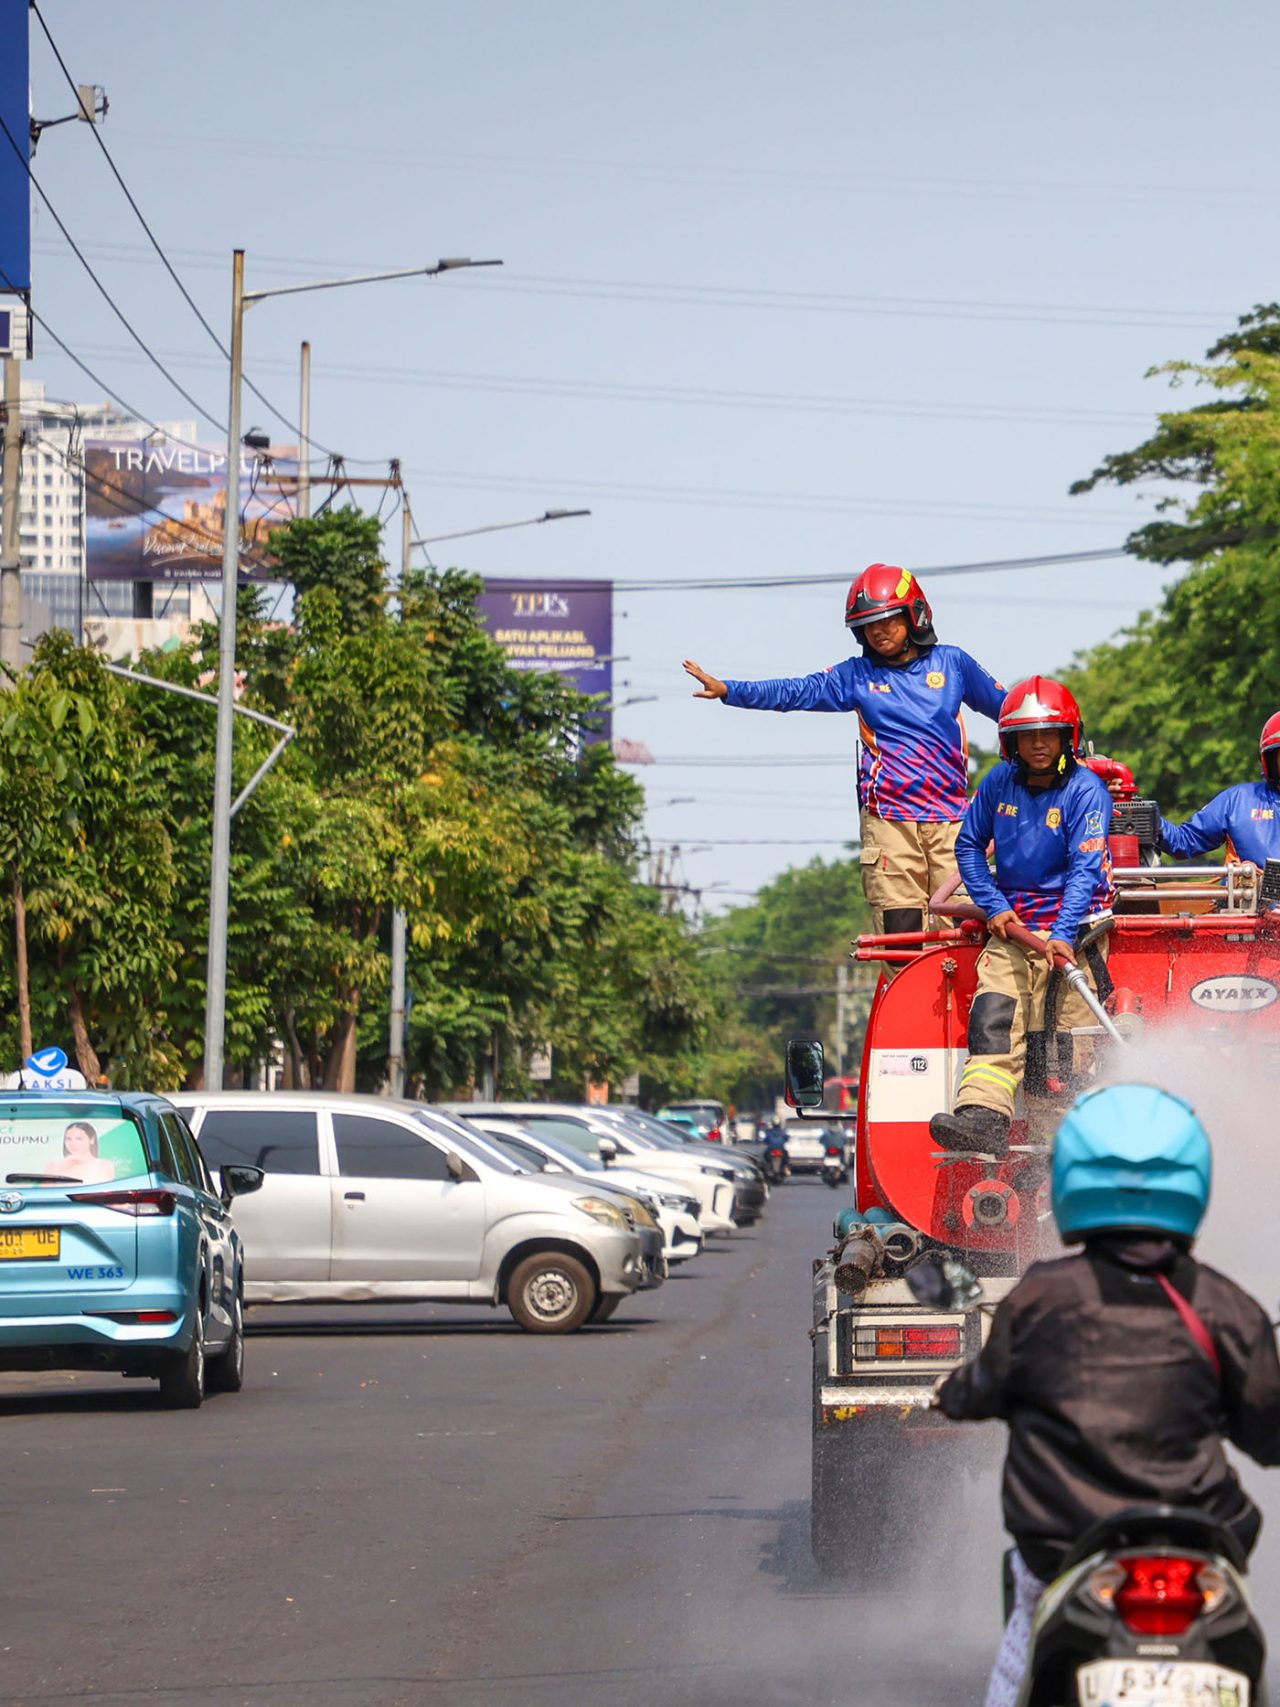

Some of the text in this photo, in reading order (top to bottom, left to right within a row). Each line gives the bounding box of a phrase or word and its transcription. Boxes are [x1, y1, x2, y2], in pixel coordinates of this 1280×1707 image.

[495, 629, 527, 643] SATU
[1198, 987, 1271, 1001] AYAXX
[913, 1060, 926, 1070] 112
[66, 1267, 124, 1280] WE 363
